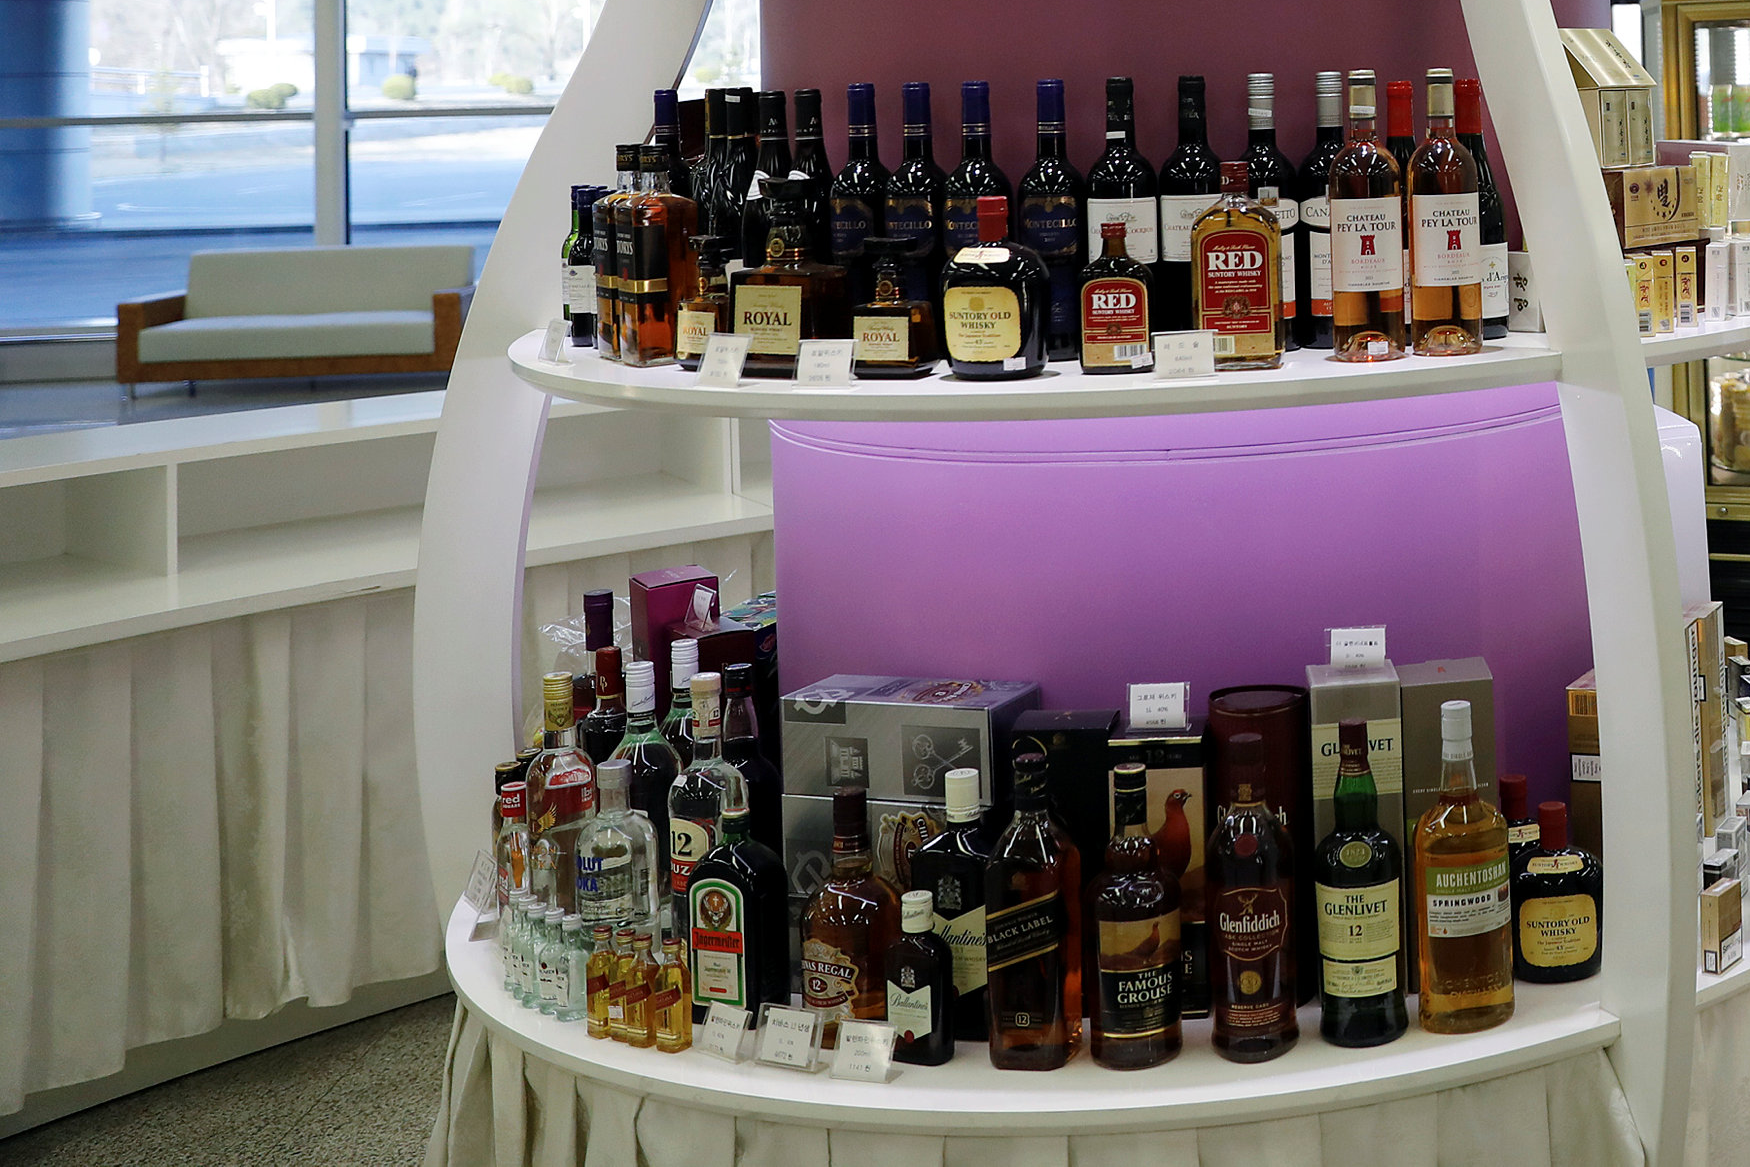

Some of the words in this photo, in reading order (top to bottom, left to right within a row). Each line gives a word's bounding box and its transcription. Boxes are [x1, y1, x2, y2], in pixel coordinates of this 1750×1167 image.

[1346, 214, 1386, 222] CHATEAU
[1432, 209, 1470, 217] CHATEAU
[1337, 223, 1352, 232] PEY
[1355, 223, 1367, 232] LA
[1370, 221, 1397, 231] TOUR
[1421, 219, 1439, 228] PEY
[1441, 218, 1454, 227] LA
[1457, 216, 1477, 226] TOUR
[1207, 251, 1263, 271] RED
[1513, 272, 1529, 312] 영광
[1091, 293, 1137, 310] RED
[743, 311, 792, 326] ROYAL
[949, 312, 989, 321] SUNTORY
[990, 311, 1011, 320] OLD
[960, 321, 997, 330] WHISKY
[862, 333, 900, 342] ROYAL
[502, 793, 520, 804] red
[672, 831, 692, 857] 12
[1436, 860, 1507, 888] AUCHENTOSHAN
[1345, 894, 1365, 904] THE
[1432, 894, 1492, 907] SPRINGWOOD
[1324, 899, 1388, 915] GLENLIVET
[1219, 910, 1280, 933] Glenfiddich
[1526, 919, 1570, 929] SUNTORY
[1571, 916, 1590, 925] OLD
[938, 924, 987, 946] llantine's
[987, 926, 1020, 944] BLACK
[1021, 916, 1054, 935] LABEL
[1348, 924, 1363, 937] 12
[1540, 927, 1577, 937] WHISKY
[817, 962, 852, 979] REGAL
[1138, 970, 1156, 979] THE
[812, 979, 821, 991] 12
[1118, 971, 1173, 992] FAMOUS
[1117, 983, 1173, 1004] GROUSE
[889, 991, 929, 1010] Ballantine's
